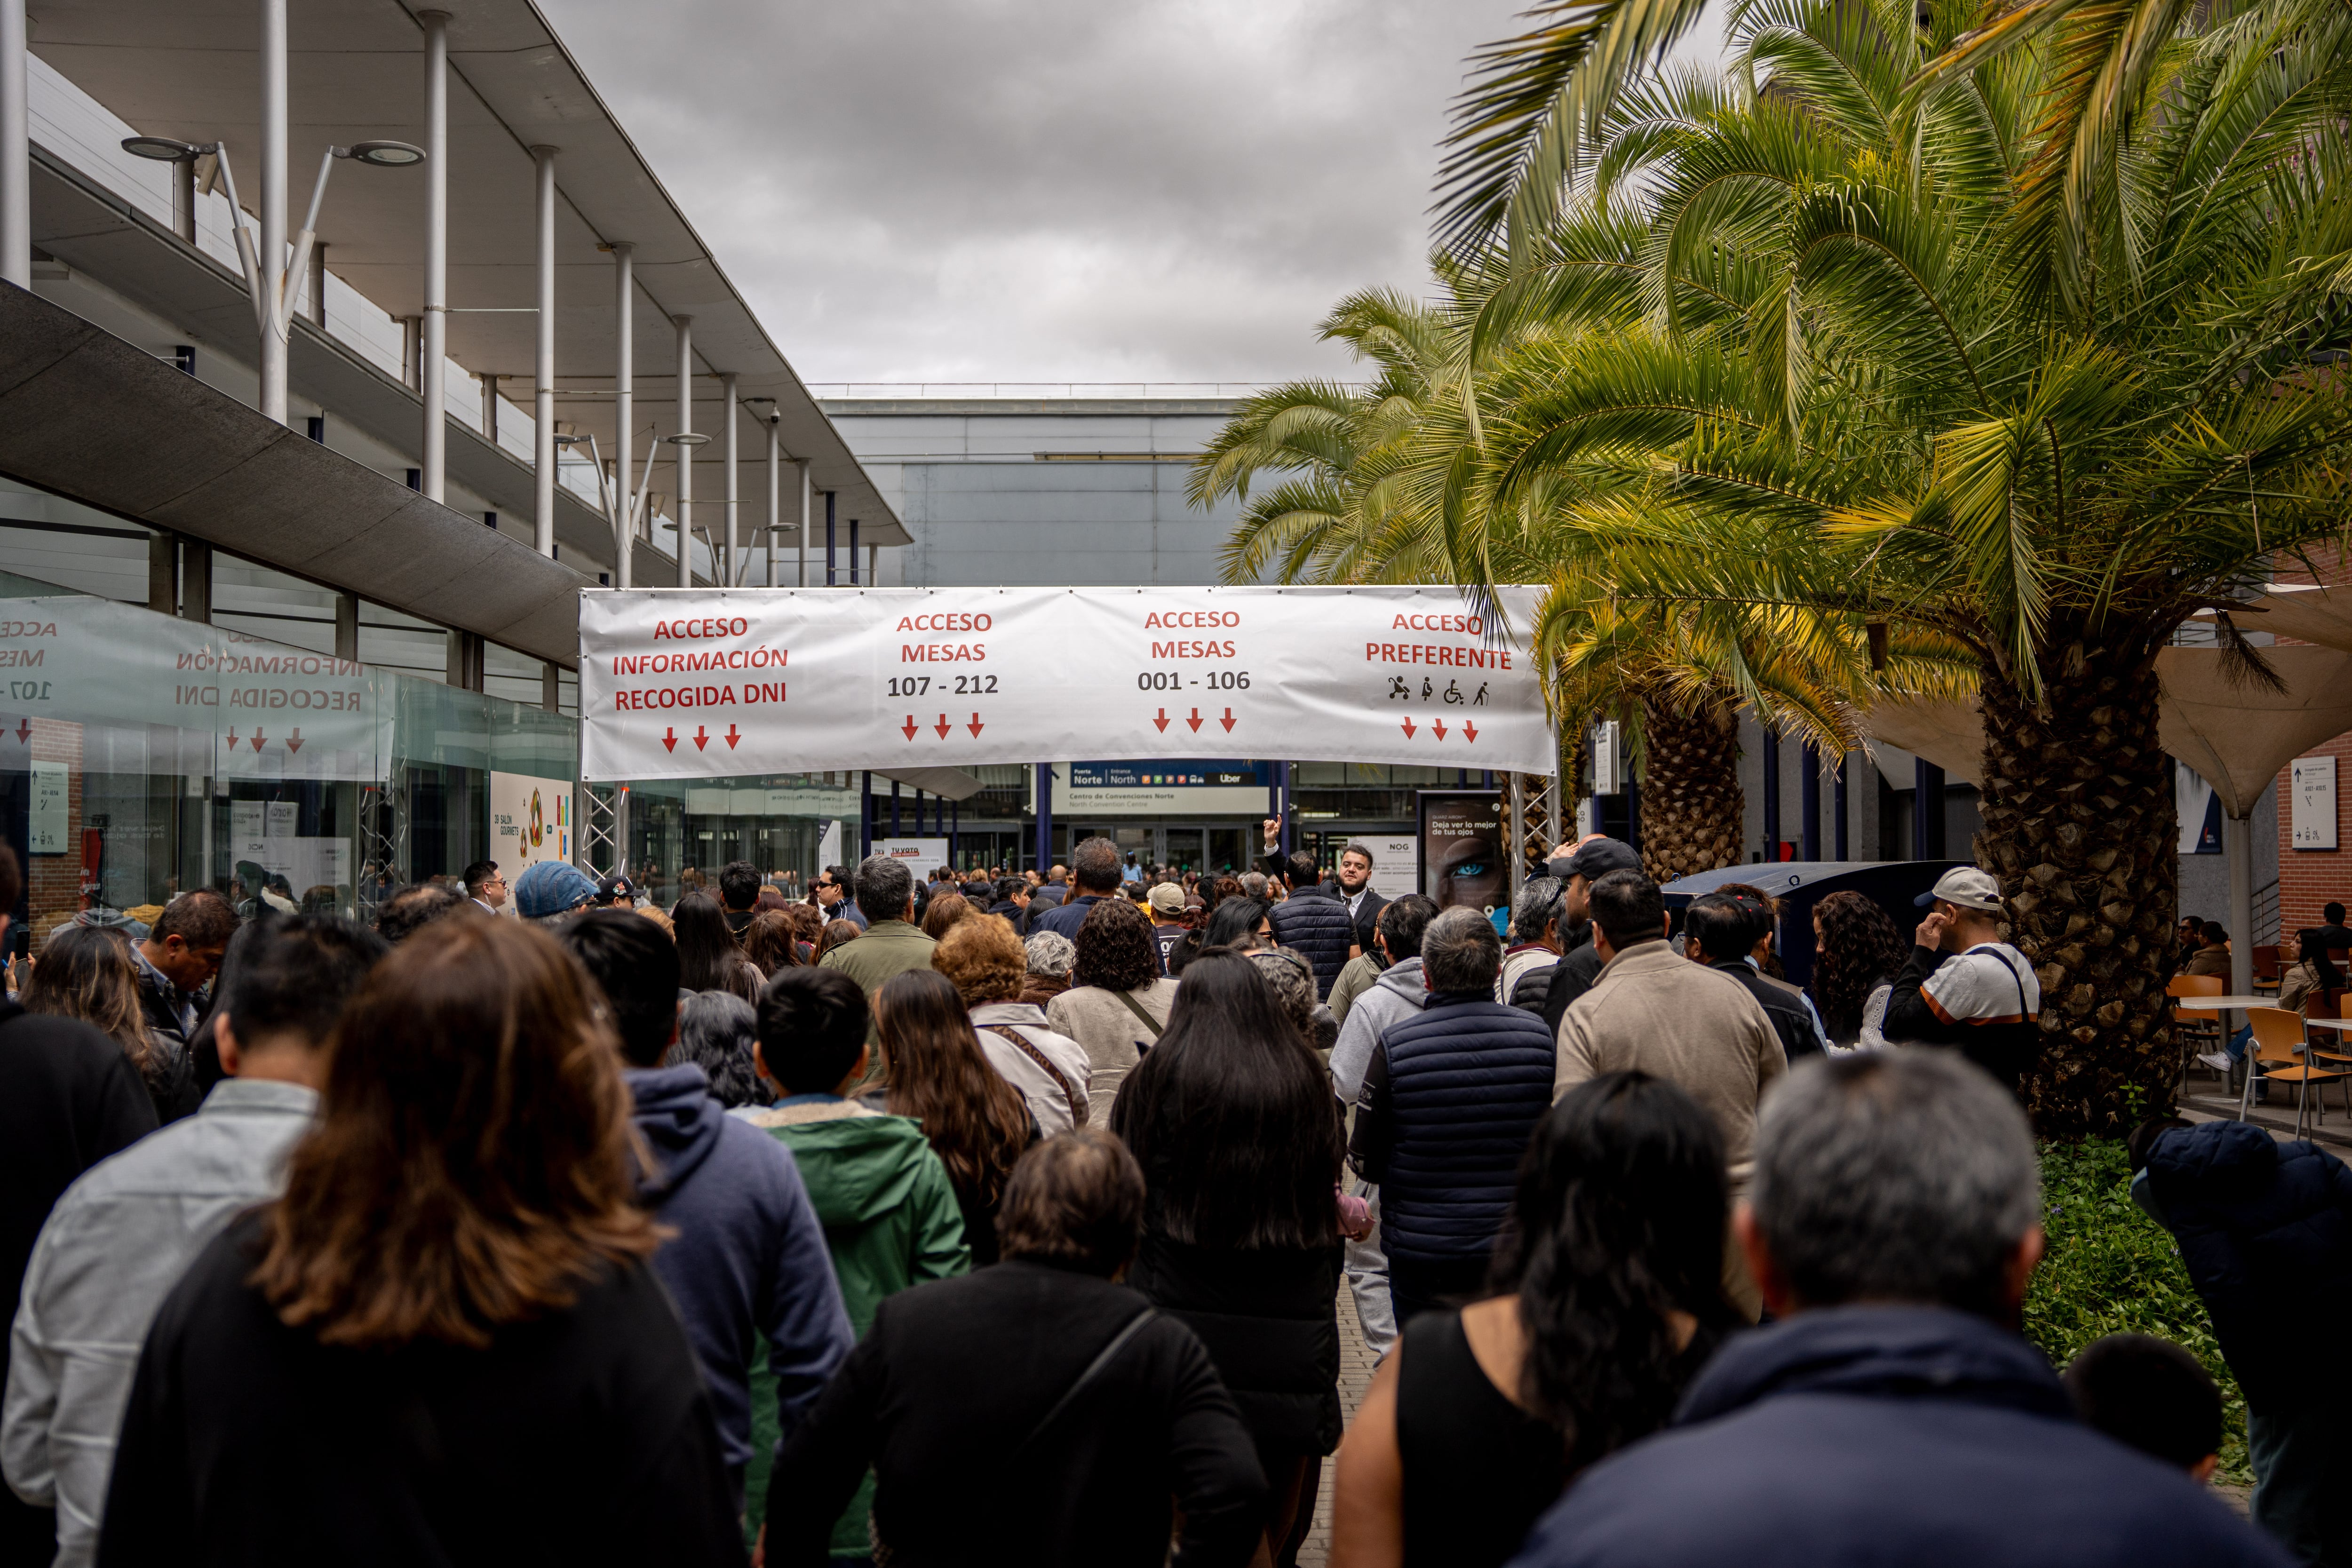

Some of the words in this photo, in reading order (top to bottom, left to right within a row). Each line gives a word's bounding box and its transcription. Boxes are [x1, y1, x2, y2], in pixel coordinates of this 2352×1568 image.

[654, 617, 748, 640] ACCESO
[897, 613, 992, 632] ACCESO
[1144, 611, 1240, 629] ACCESO
[1393, 614, 1482, 636] ACCESO
[902, 644, 985, 663] MESAS
[1152, 640, 1236, 659] MESAS
[1367, 643, 1511, 670] PREFERENTE
[613, 645, 788, 676] INFORMACIÓN
[888, 677, 930, 697] 107
[955, 675, 998, 694] 212
[1138, 672, 1182, 690] 001
[1207, 671, 1250, 690] 106
[615, 685, 737, 711] RECOGIDA
[744, 682, 786, 704] DNI
[1074, 776, 1102, 784] Norte
[1111, 775, 1136, 784] North
[1220, 774, 1241, 783] Uber
[494, 814, 499, 824] 39
[501, 812, 512, 825] SALÓN
[1475, 821, 1497, 829] mejor
[500, 826, 519, 836] GOURMETS
[1457, 828, 1474, 836] ojos
